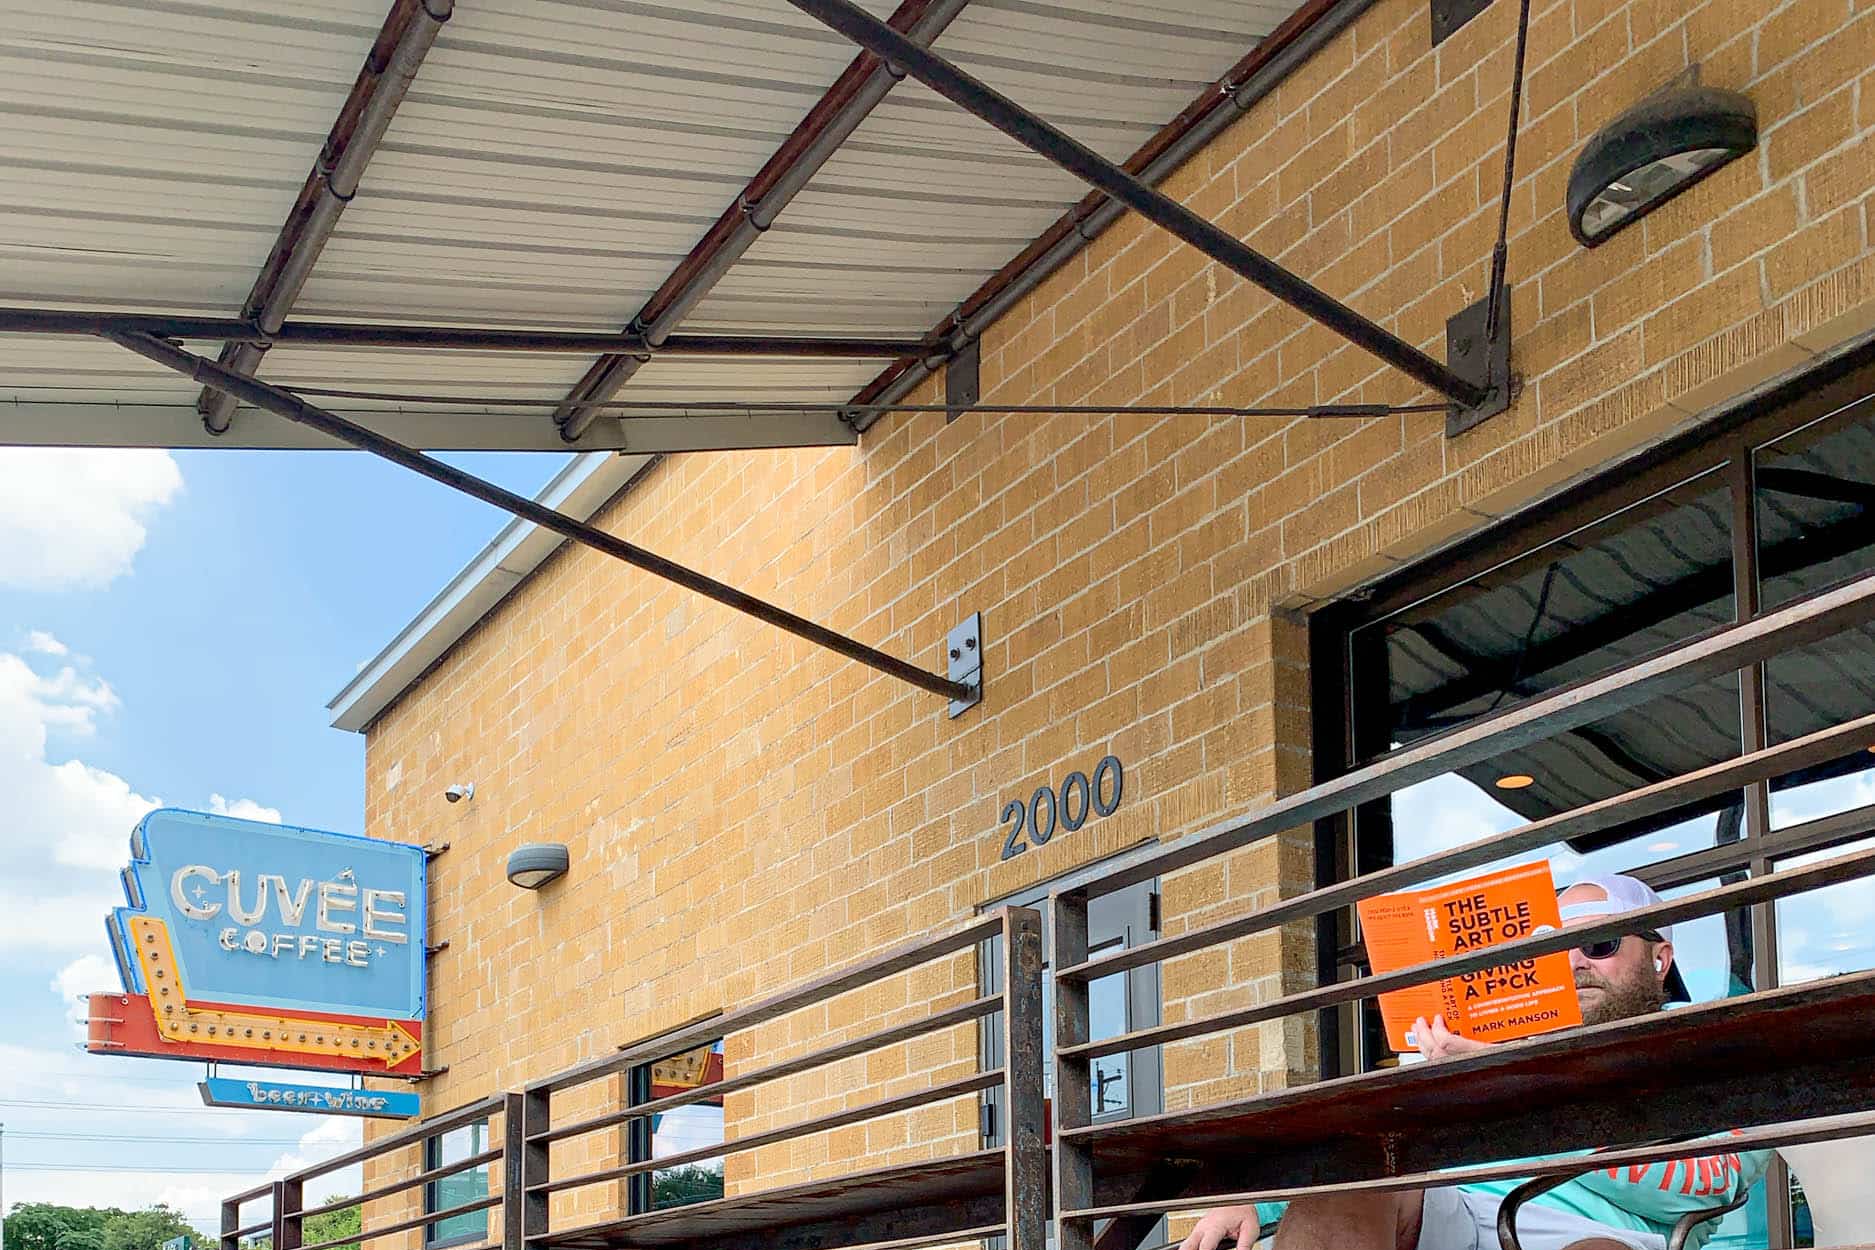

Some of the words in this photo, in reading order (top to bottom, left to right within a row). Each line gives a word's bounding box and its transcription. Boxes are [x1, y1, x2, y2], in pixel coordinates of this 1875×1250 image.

[1001, 756, 1123, 860] 2000
[171, 866, 407, 944] CUVÉE
[1444, 895, 1487, 916] THE
[1449, 902, 1530, 934] SUBTLE
[219, 928, 369, 967] COFFEE
[1454, 928, 1494, 951] ART
[1502, 919, 1531, 938] OF
[1465, 985, 1480, 1000] A
[1472, 1021, 1505, 1035] MARK
[1509, 1010, 1559, 1027] MANSON
